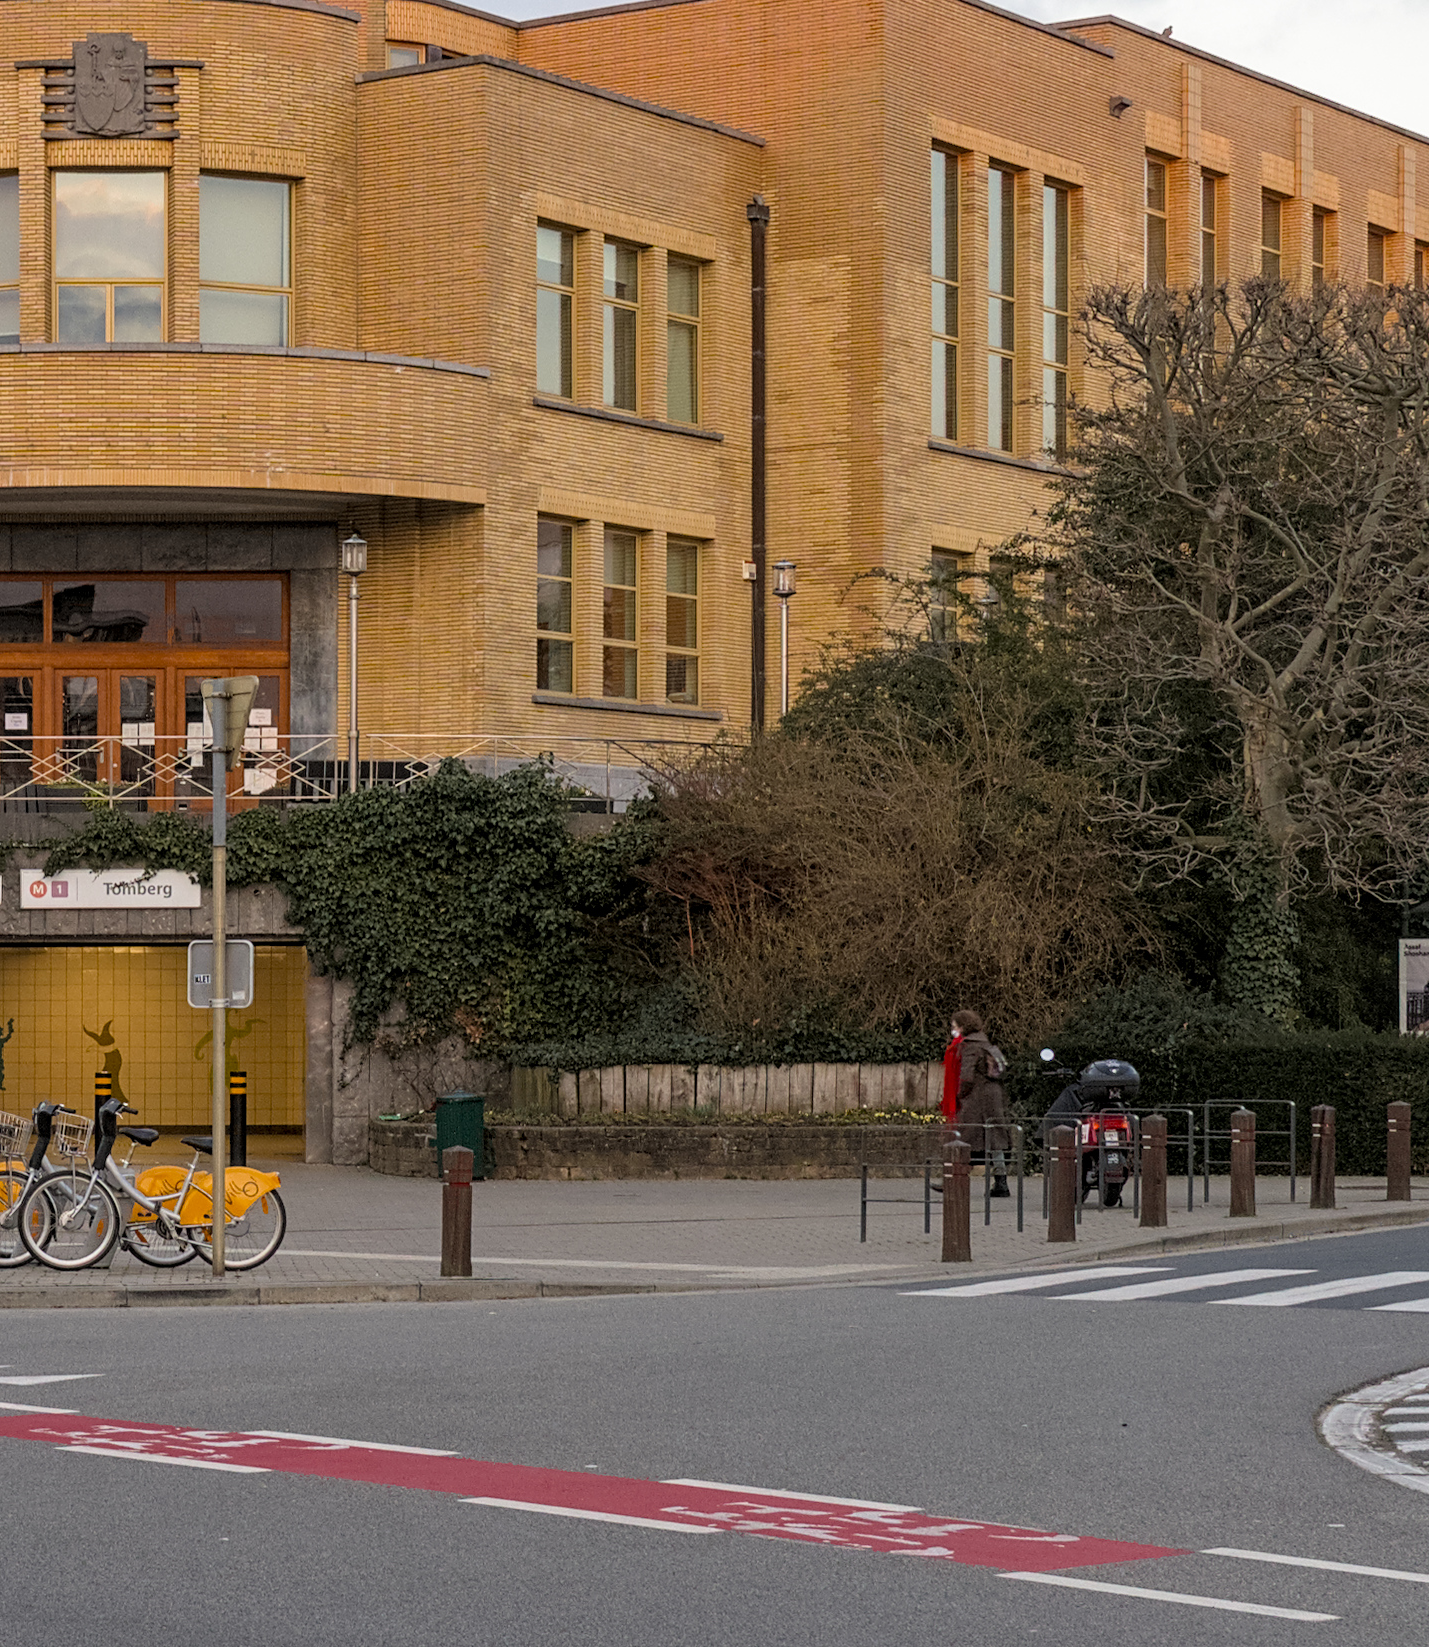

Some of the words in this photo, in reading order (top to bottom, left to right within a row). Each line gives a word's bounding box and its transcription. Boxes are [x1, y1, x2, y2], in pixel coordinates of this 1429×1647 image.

[32, 884, 45, 895] M
[56, 884, 62, 894] 1
[103, 882, 173, 898] Tomberg
